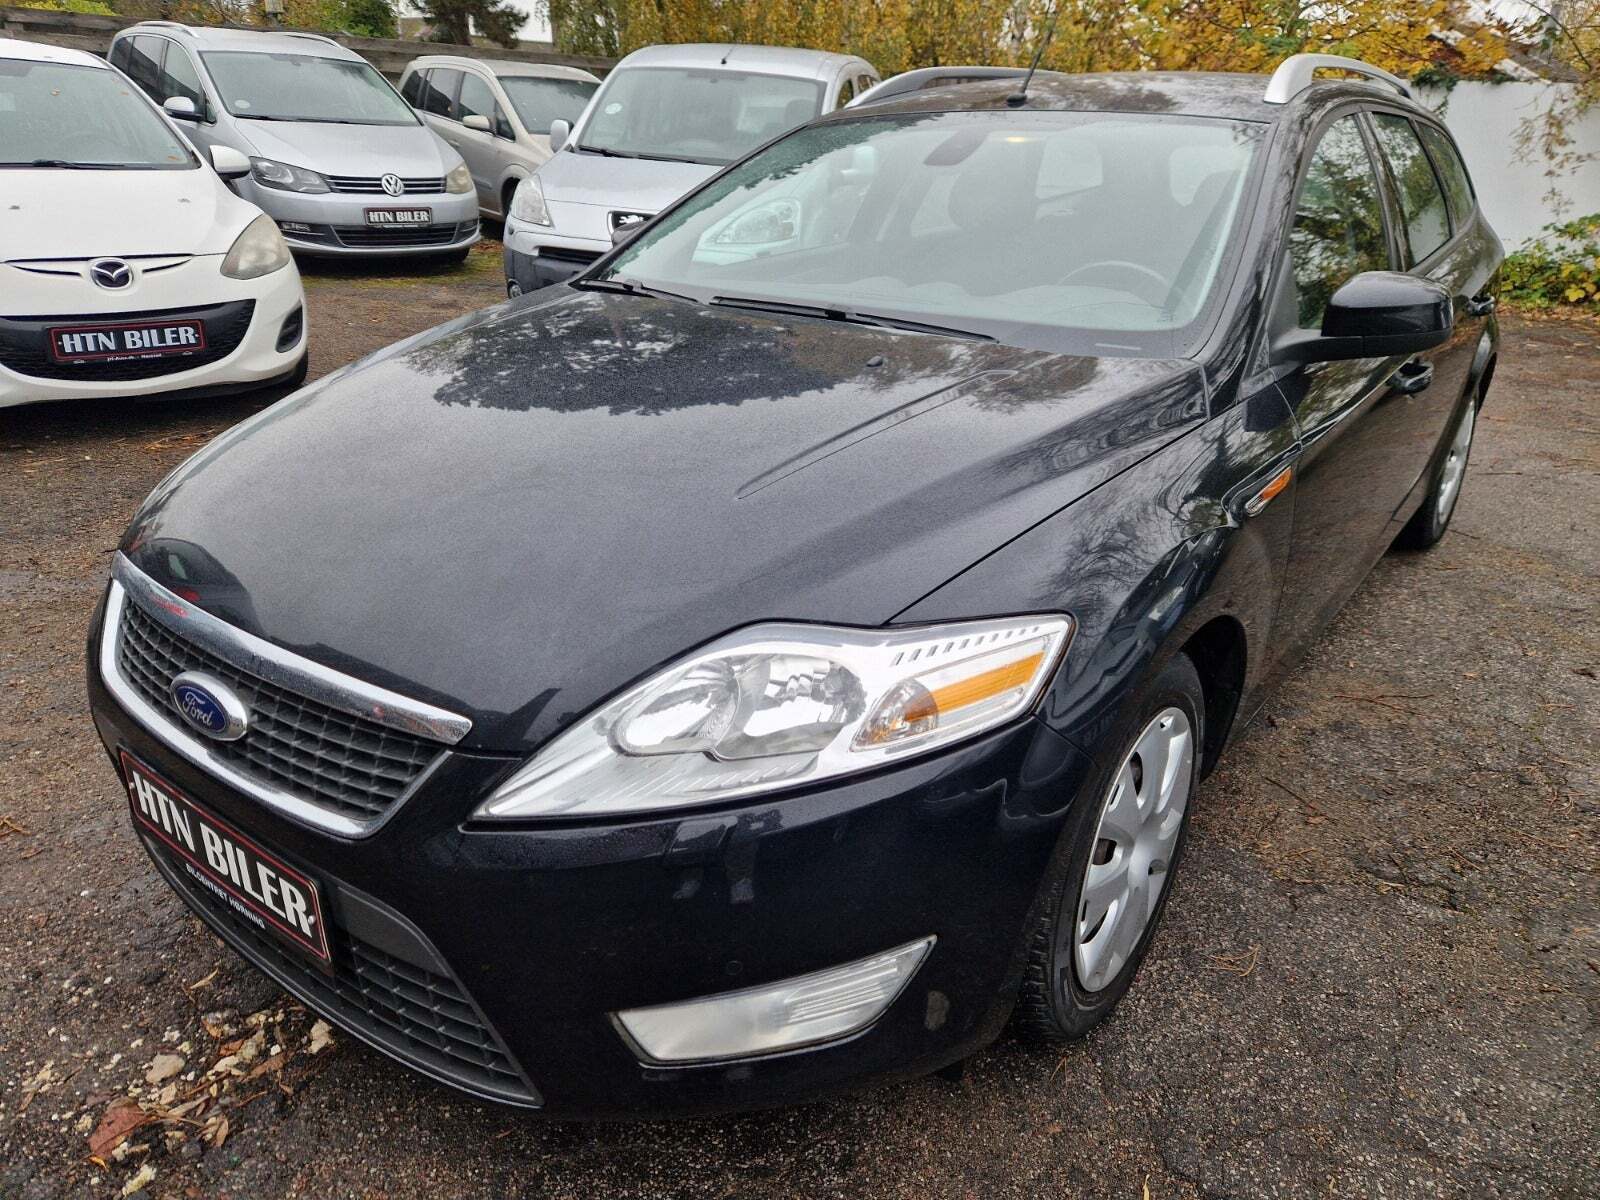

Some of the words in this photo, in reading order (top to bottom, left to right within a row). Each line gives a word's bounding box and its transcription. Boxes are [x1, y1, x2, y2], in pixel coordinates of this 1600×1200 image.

[369, 211, 394, 222] HTN
[396, 210, 429, 222] BILER
[61, 332, 117, 353] HTN
[124, 326, 197, 349] BILER
[182, 691, 215, 726] Ford
[132, 770, 196, 853] HTN
[199, 822, 313, 938] BILER
